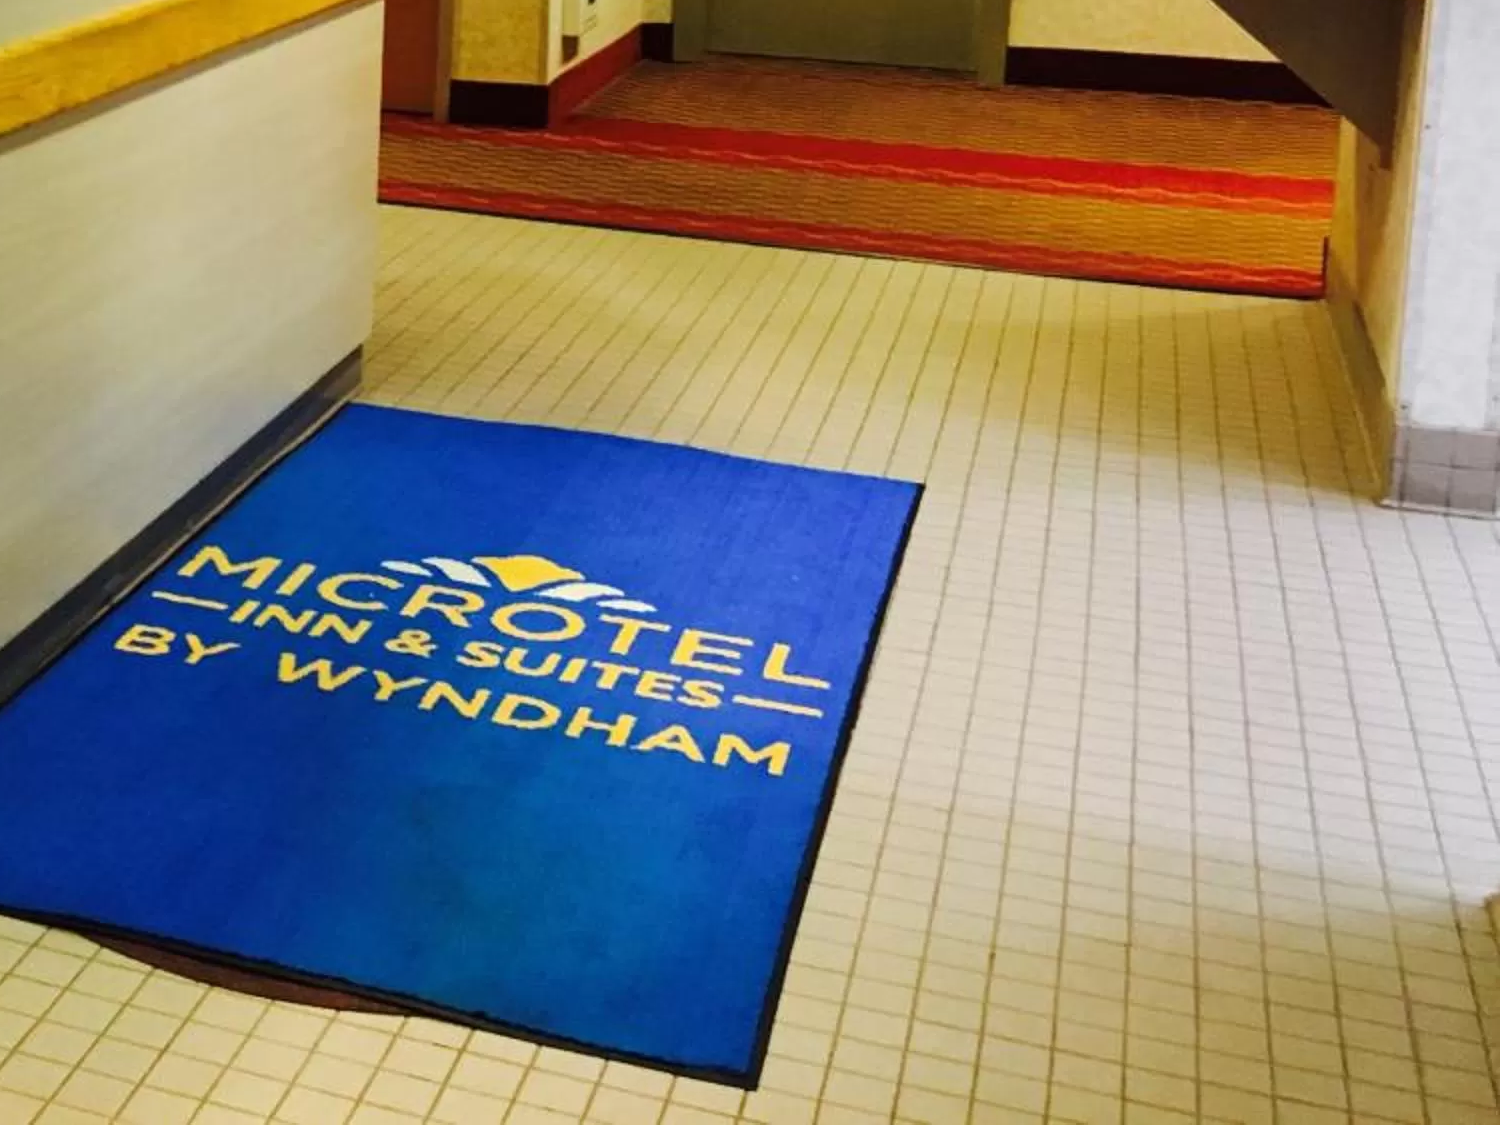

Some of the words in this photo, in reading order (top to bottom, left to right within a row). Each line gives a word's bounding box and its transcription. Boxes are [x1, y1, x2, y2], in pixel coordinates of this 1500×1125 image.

[177, 544, 831, 690] MICROTEL
[229, 599, 373, 644] INN
[384, 628, 438, 658] &
[456, 640, 726, 709] SUITES
[113, 624, 242, 665] BY
[277, 651, 791, 776] WYNDHAM
